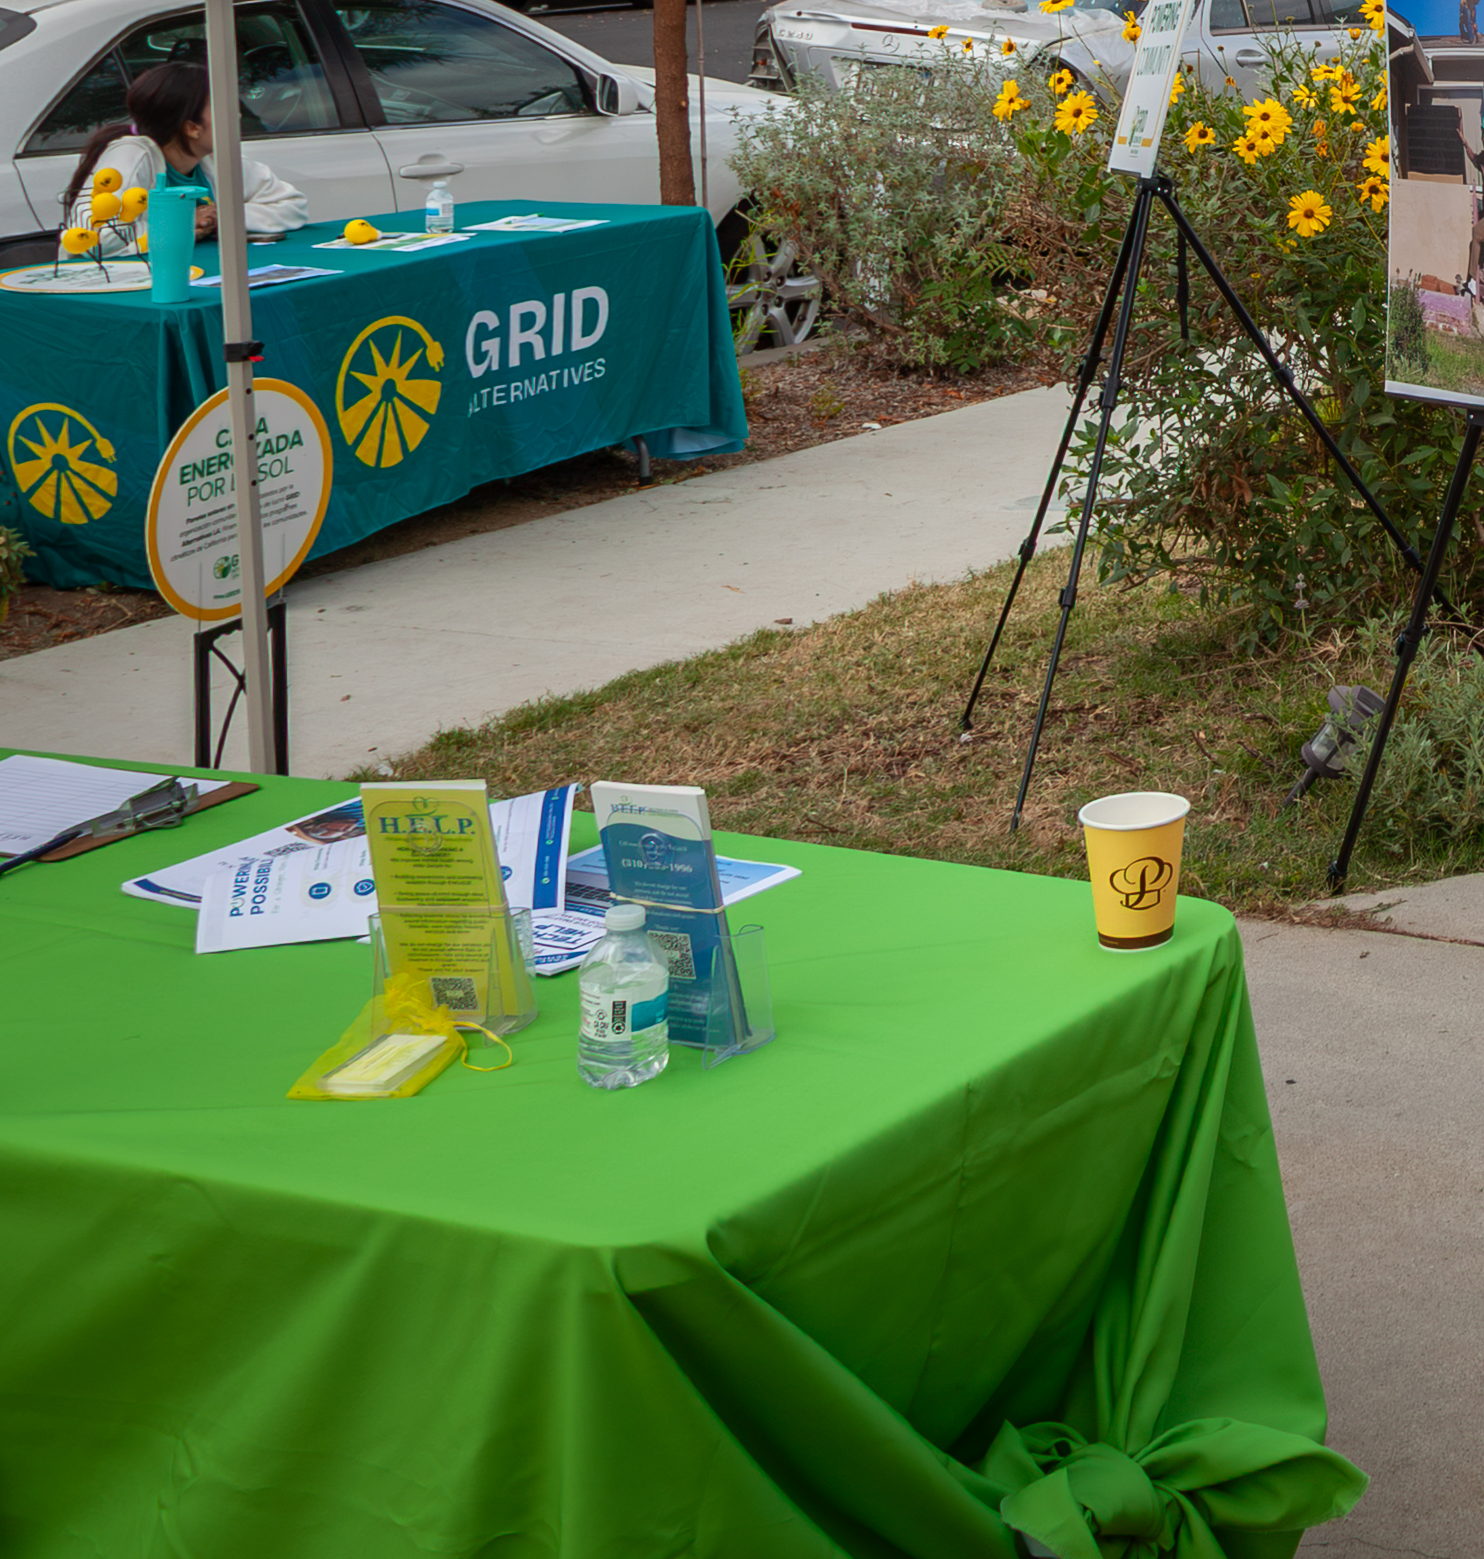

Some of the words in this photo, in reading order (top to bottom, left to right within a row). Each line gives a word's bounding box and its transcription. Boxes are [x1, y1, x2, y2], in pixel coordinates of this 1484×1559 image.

[465, 285, 610, 379] GRID
[178, 429, 304, 486] ENERZADA
[186, 476, 226, 508] POR
